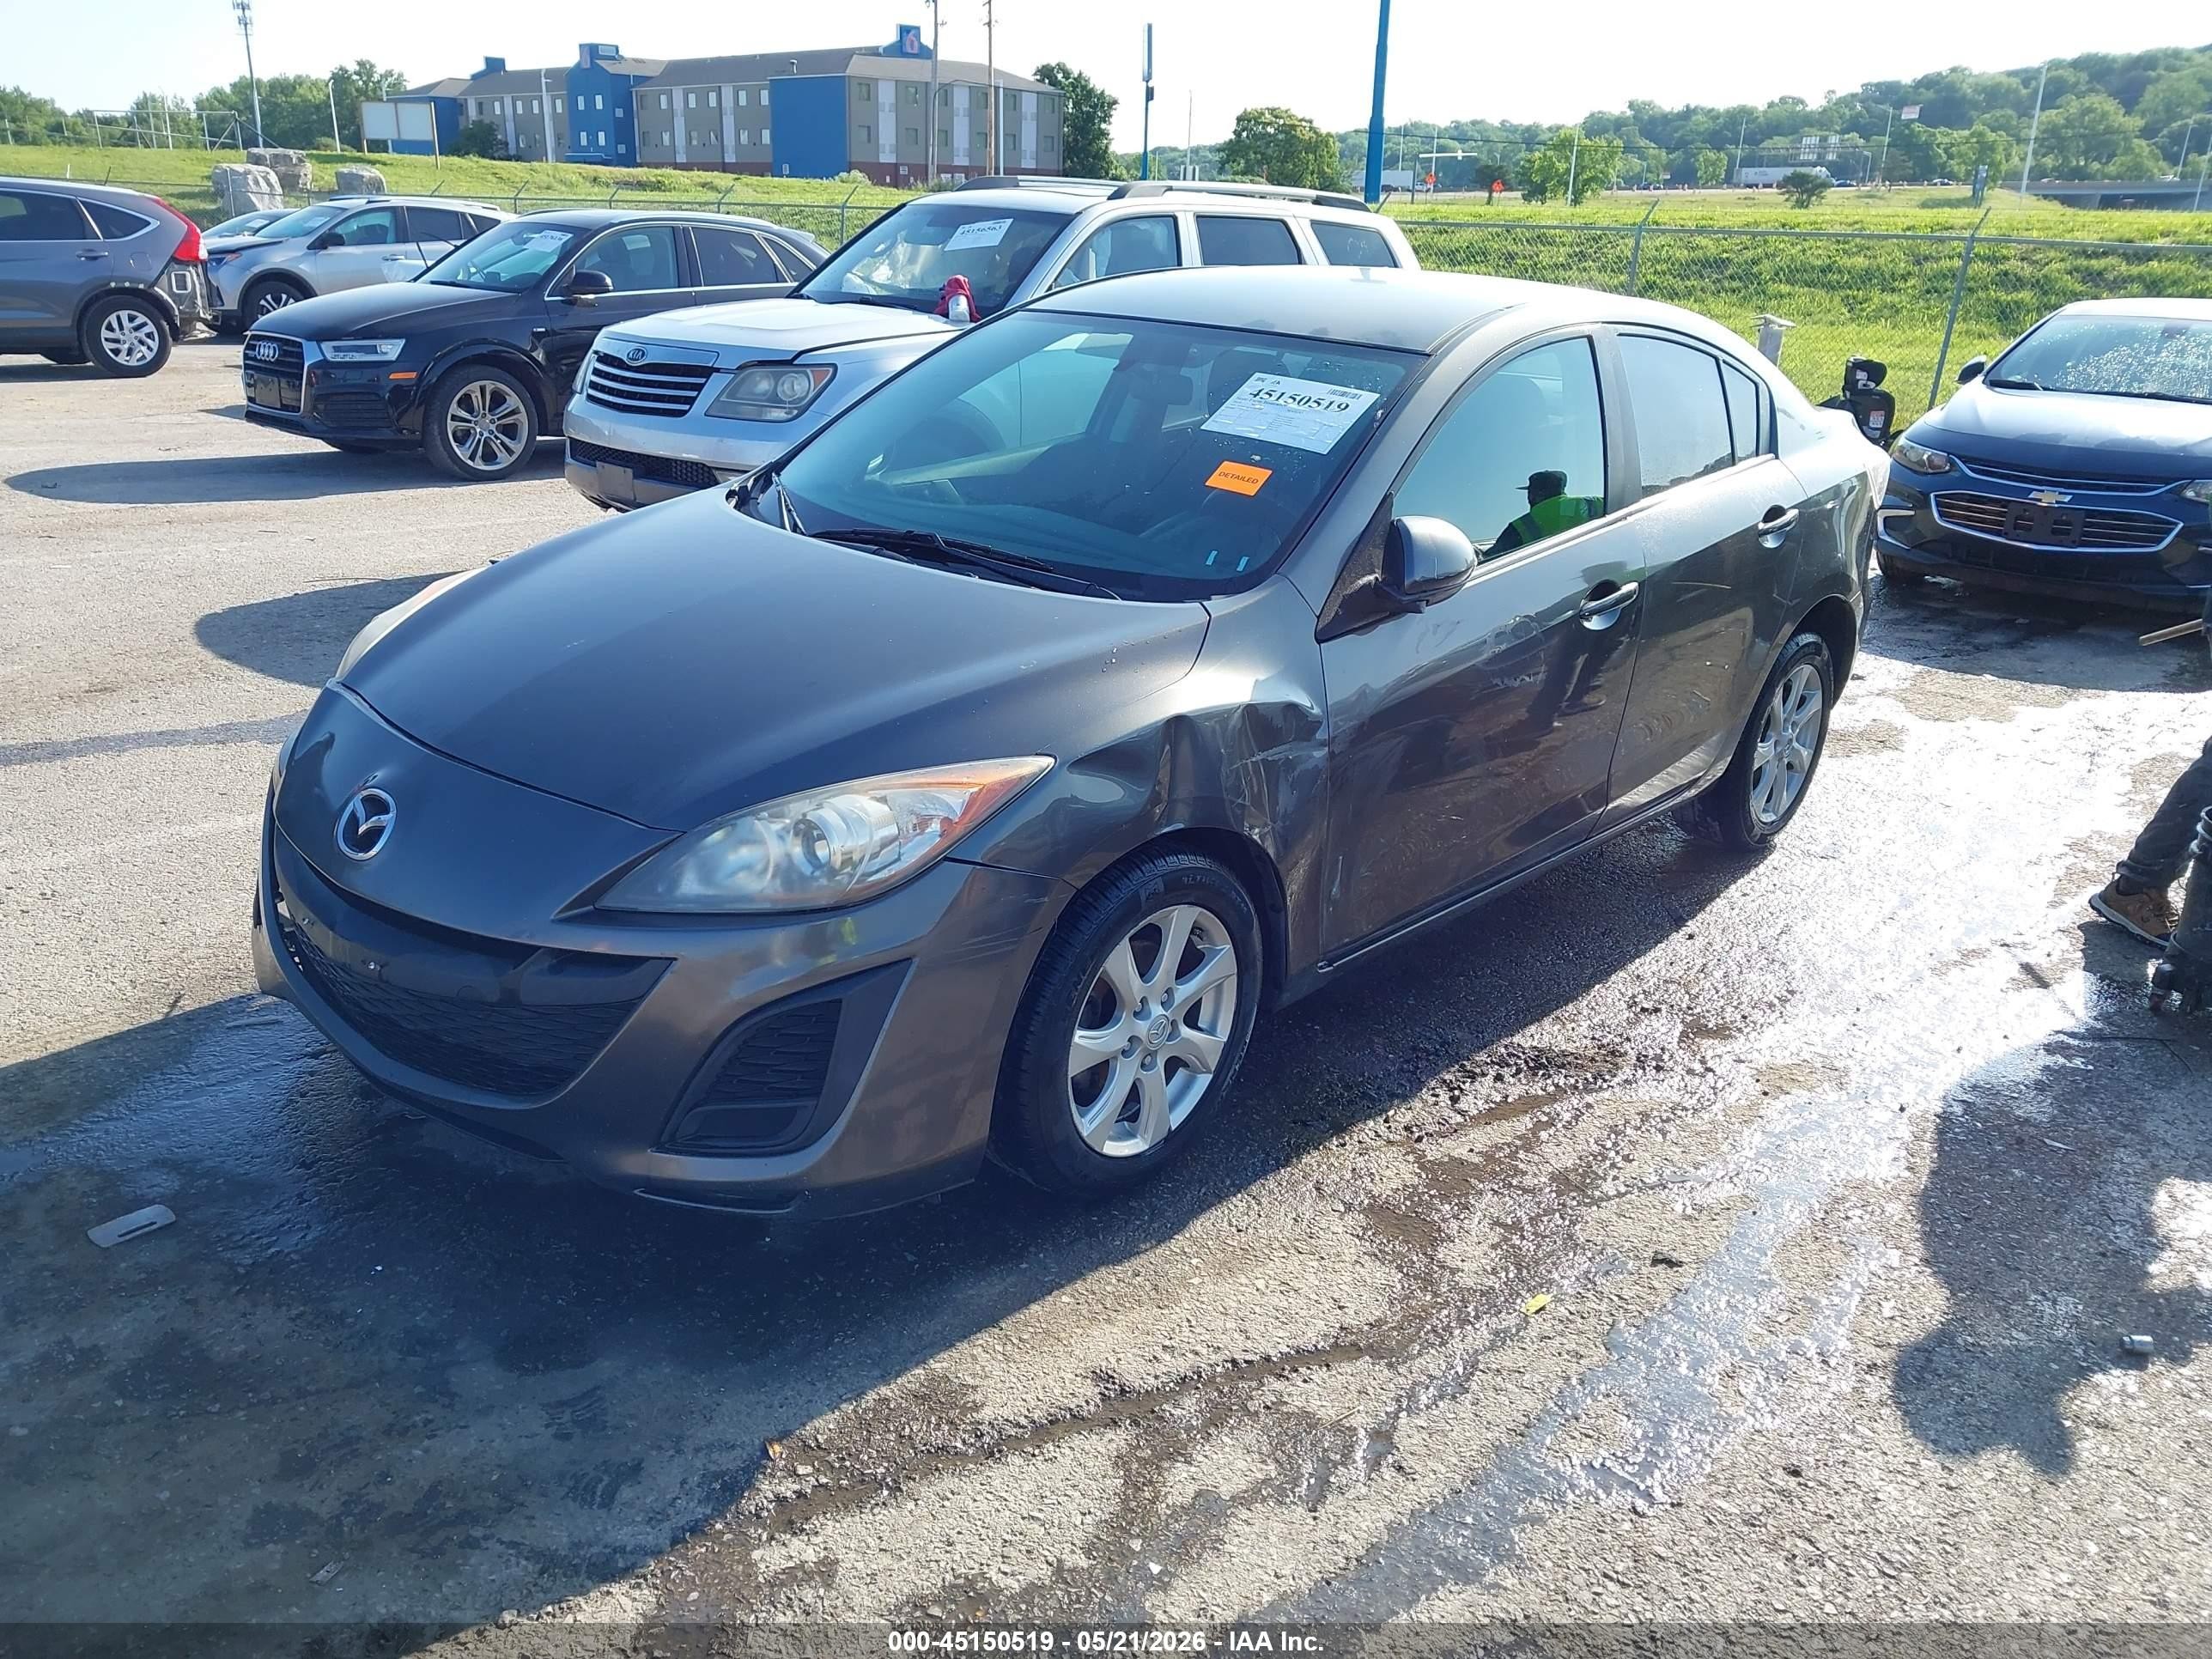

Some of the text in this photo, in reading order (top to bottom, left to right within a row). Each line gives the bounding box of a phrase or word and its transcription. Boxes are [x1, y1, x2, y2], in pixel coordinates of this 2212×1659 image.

[628, 349, 642, 360] KIA
[1249, 388, 1350, 412] 45150519
[1218, 471, 1259, 485] DETAILED
